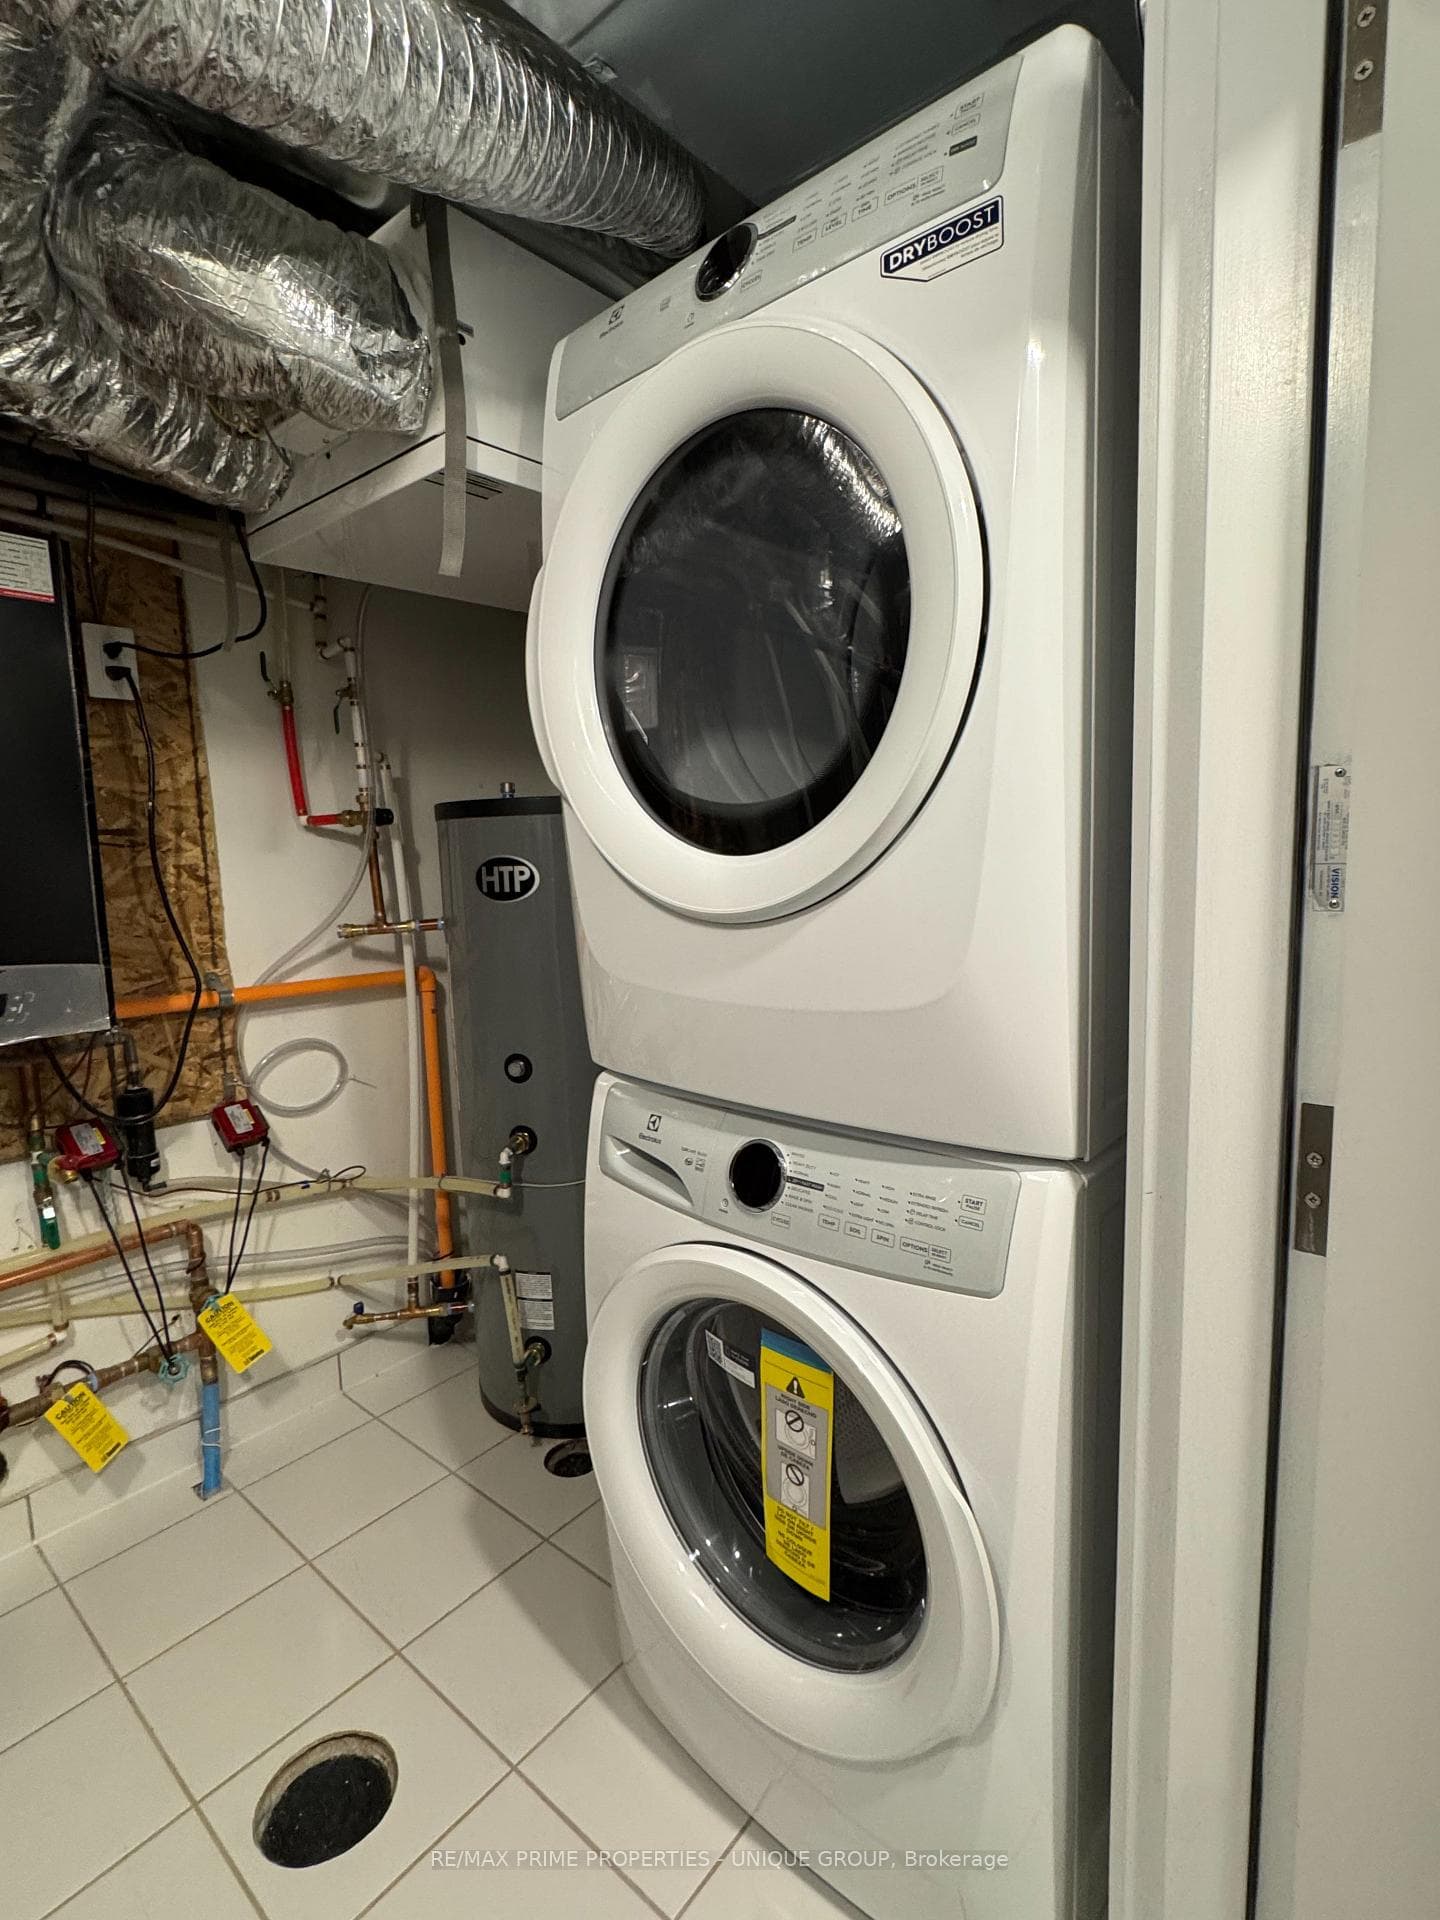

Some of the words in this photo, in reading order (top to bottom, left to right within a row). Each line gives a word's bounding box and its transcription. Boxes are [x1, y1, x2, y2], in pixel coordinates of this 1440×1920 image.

[887, 183, 916, 201] OPTIONS
[889, 205, 995, 271] DRYBOOST
[481, 865, 531, 893] HTP
[1331, 867, 1340, 899] VISION
[965, 1198, 984, 1206] START
[961, 1220, 980, 1228] CANCEL
[902, 1242, 928, 1253] OPTIONS
